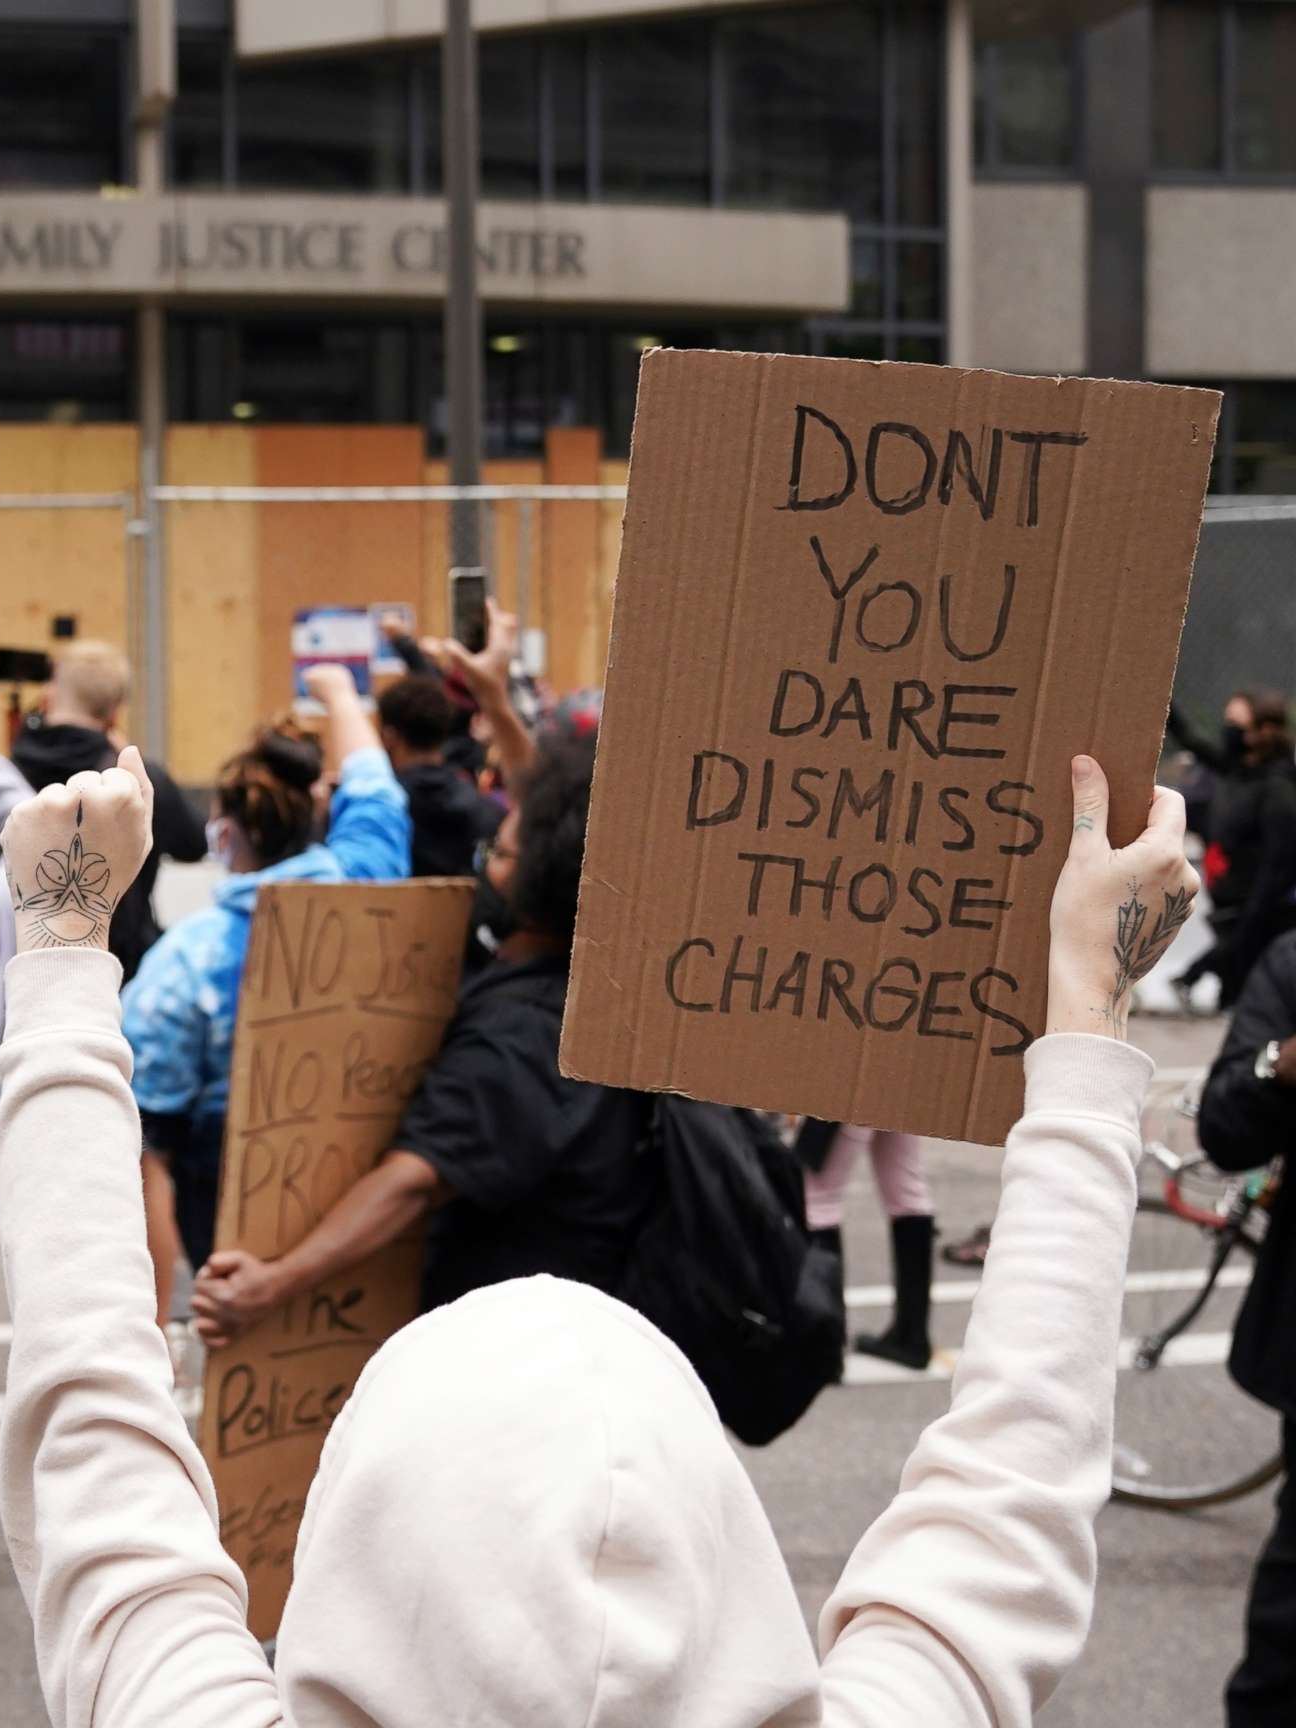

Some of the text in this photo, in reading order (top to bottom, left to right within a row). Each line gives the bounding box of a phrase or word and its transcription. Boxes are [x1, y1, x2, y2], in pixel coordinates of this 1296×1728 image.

[156, 221, 362, 277] JUSTICE
[775, 404, 1088, 527] DONT
[810, 536, 1016, 663] YOU
[769, 669, 1018, 760] DARE
[686, 750, 1044, 857] DISMISS
[738, 852, 1012, 938] THOSE
[260, 892, 346, 1009] NO
[665, 935, 1036, 1056] CHARGES
[248, 1041, 325, 1123] NO
